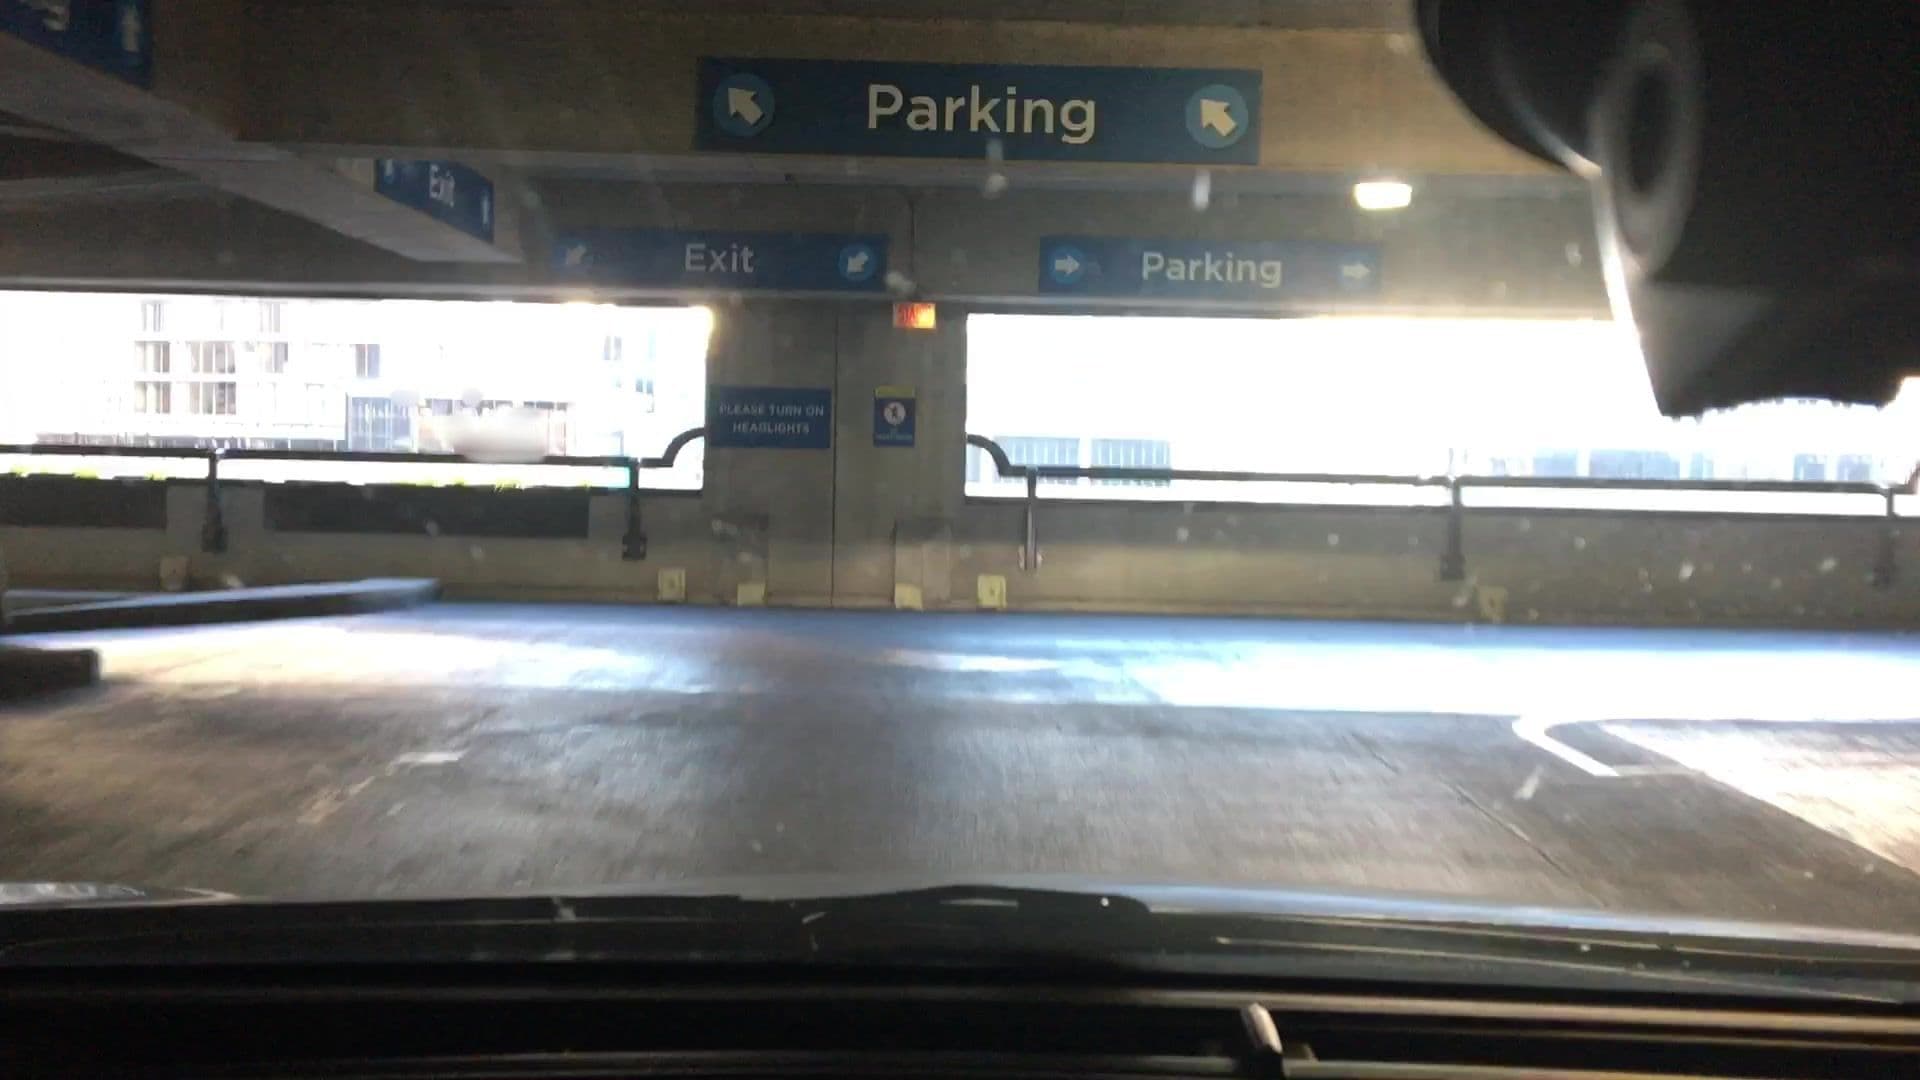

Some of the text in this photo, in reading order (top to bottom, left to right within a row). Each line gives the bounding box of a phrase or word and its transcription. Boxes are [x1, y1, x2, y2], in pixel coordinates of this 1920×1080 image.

[868, 84, 1096, 145] Parking
[429, 164, 456, 208] Exit
[685, 244, 755, 273] Exit
[1142, 252, 1281, 288] Parking
[719, 404, 825, 418] PLEASE TURN ON
[732, 421, 811, 434] HEADLIGHTS
